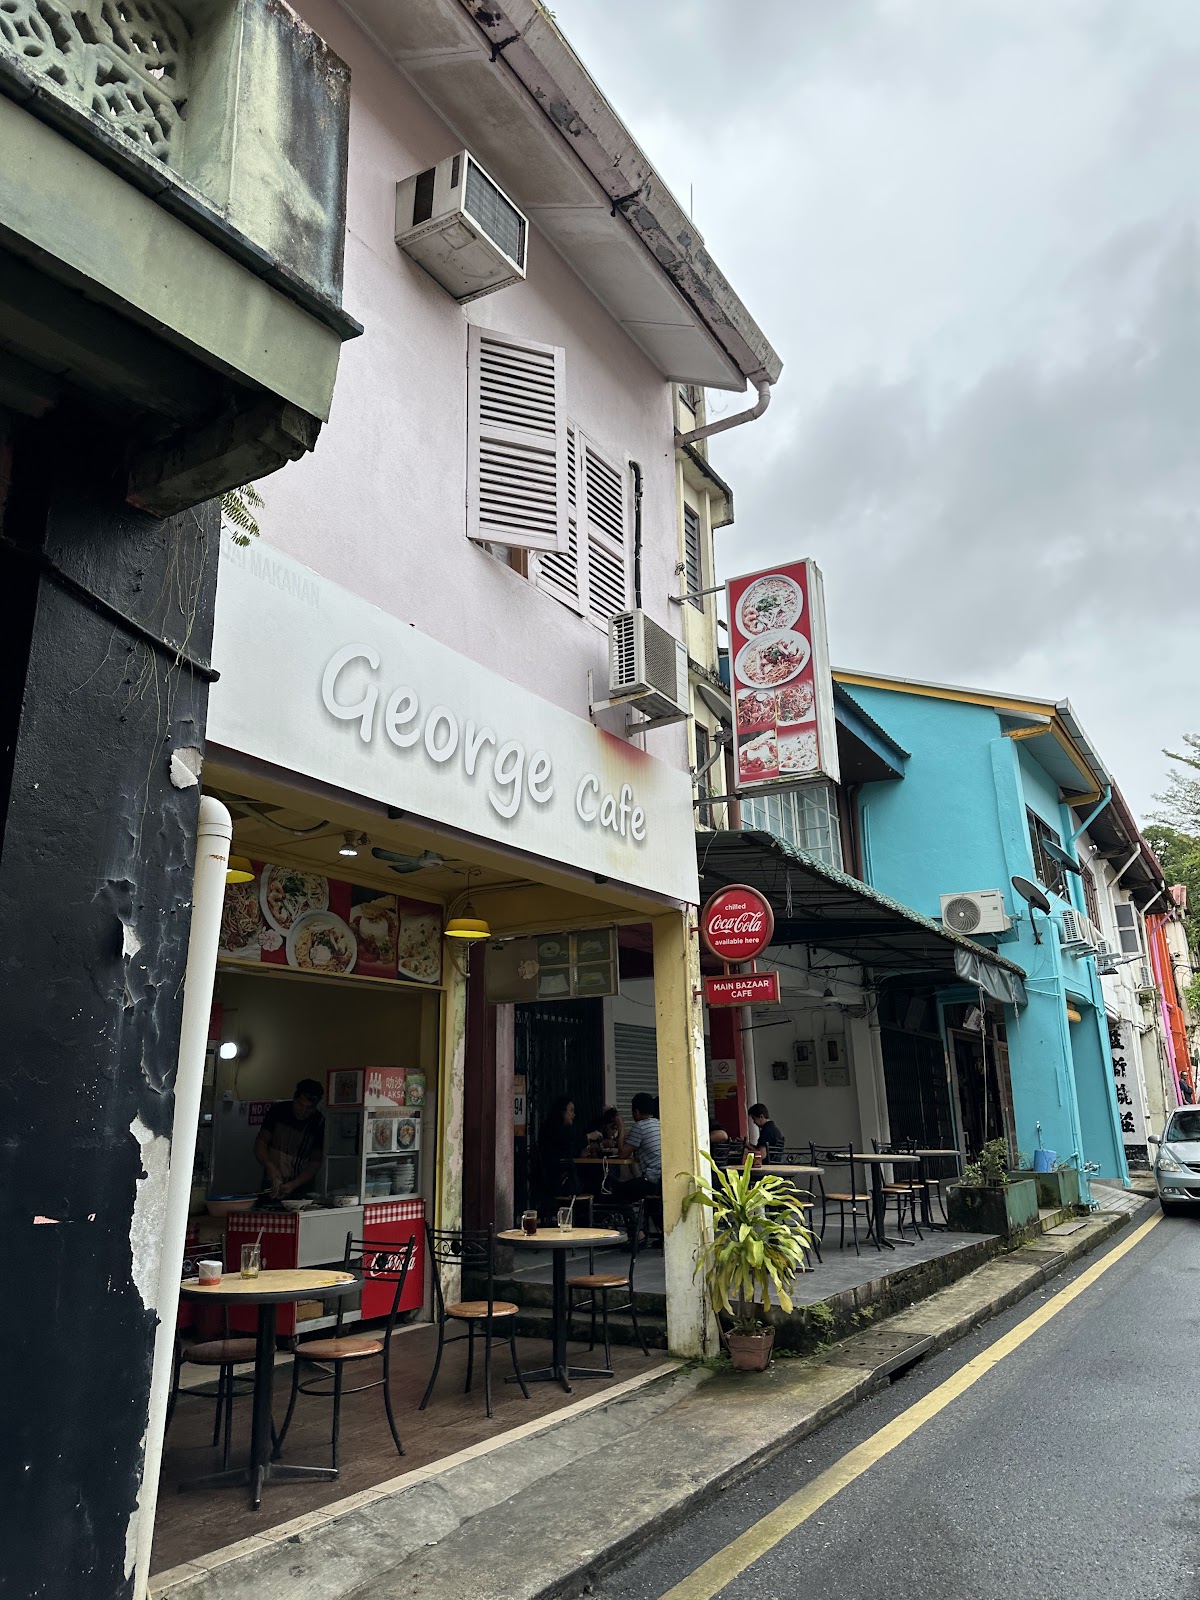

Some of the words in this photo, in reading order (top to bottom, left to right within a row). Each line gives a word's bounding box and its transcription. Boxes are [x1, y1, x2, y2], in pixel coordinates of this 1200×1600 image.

[321, 643, 554, 819] George
[575, 773, 647, 841] Cafe
[724, 903, 747, 911] chilled
[714, 938, 744, 946] available
[713, 982, 734, 991] MAIN
[735, 980, 769, 990] BAZAAR
[731, 990, 752, 998] CAFE
[383, 1090, 406, 1098] LAKSA
[251, 1104, 263, 1115] NO
